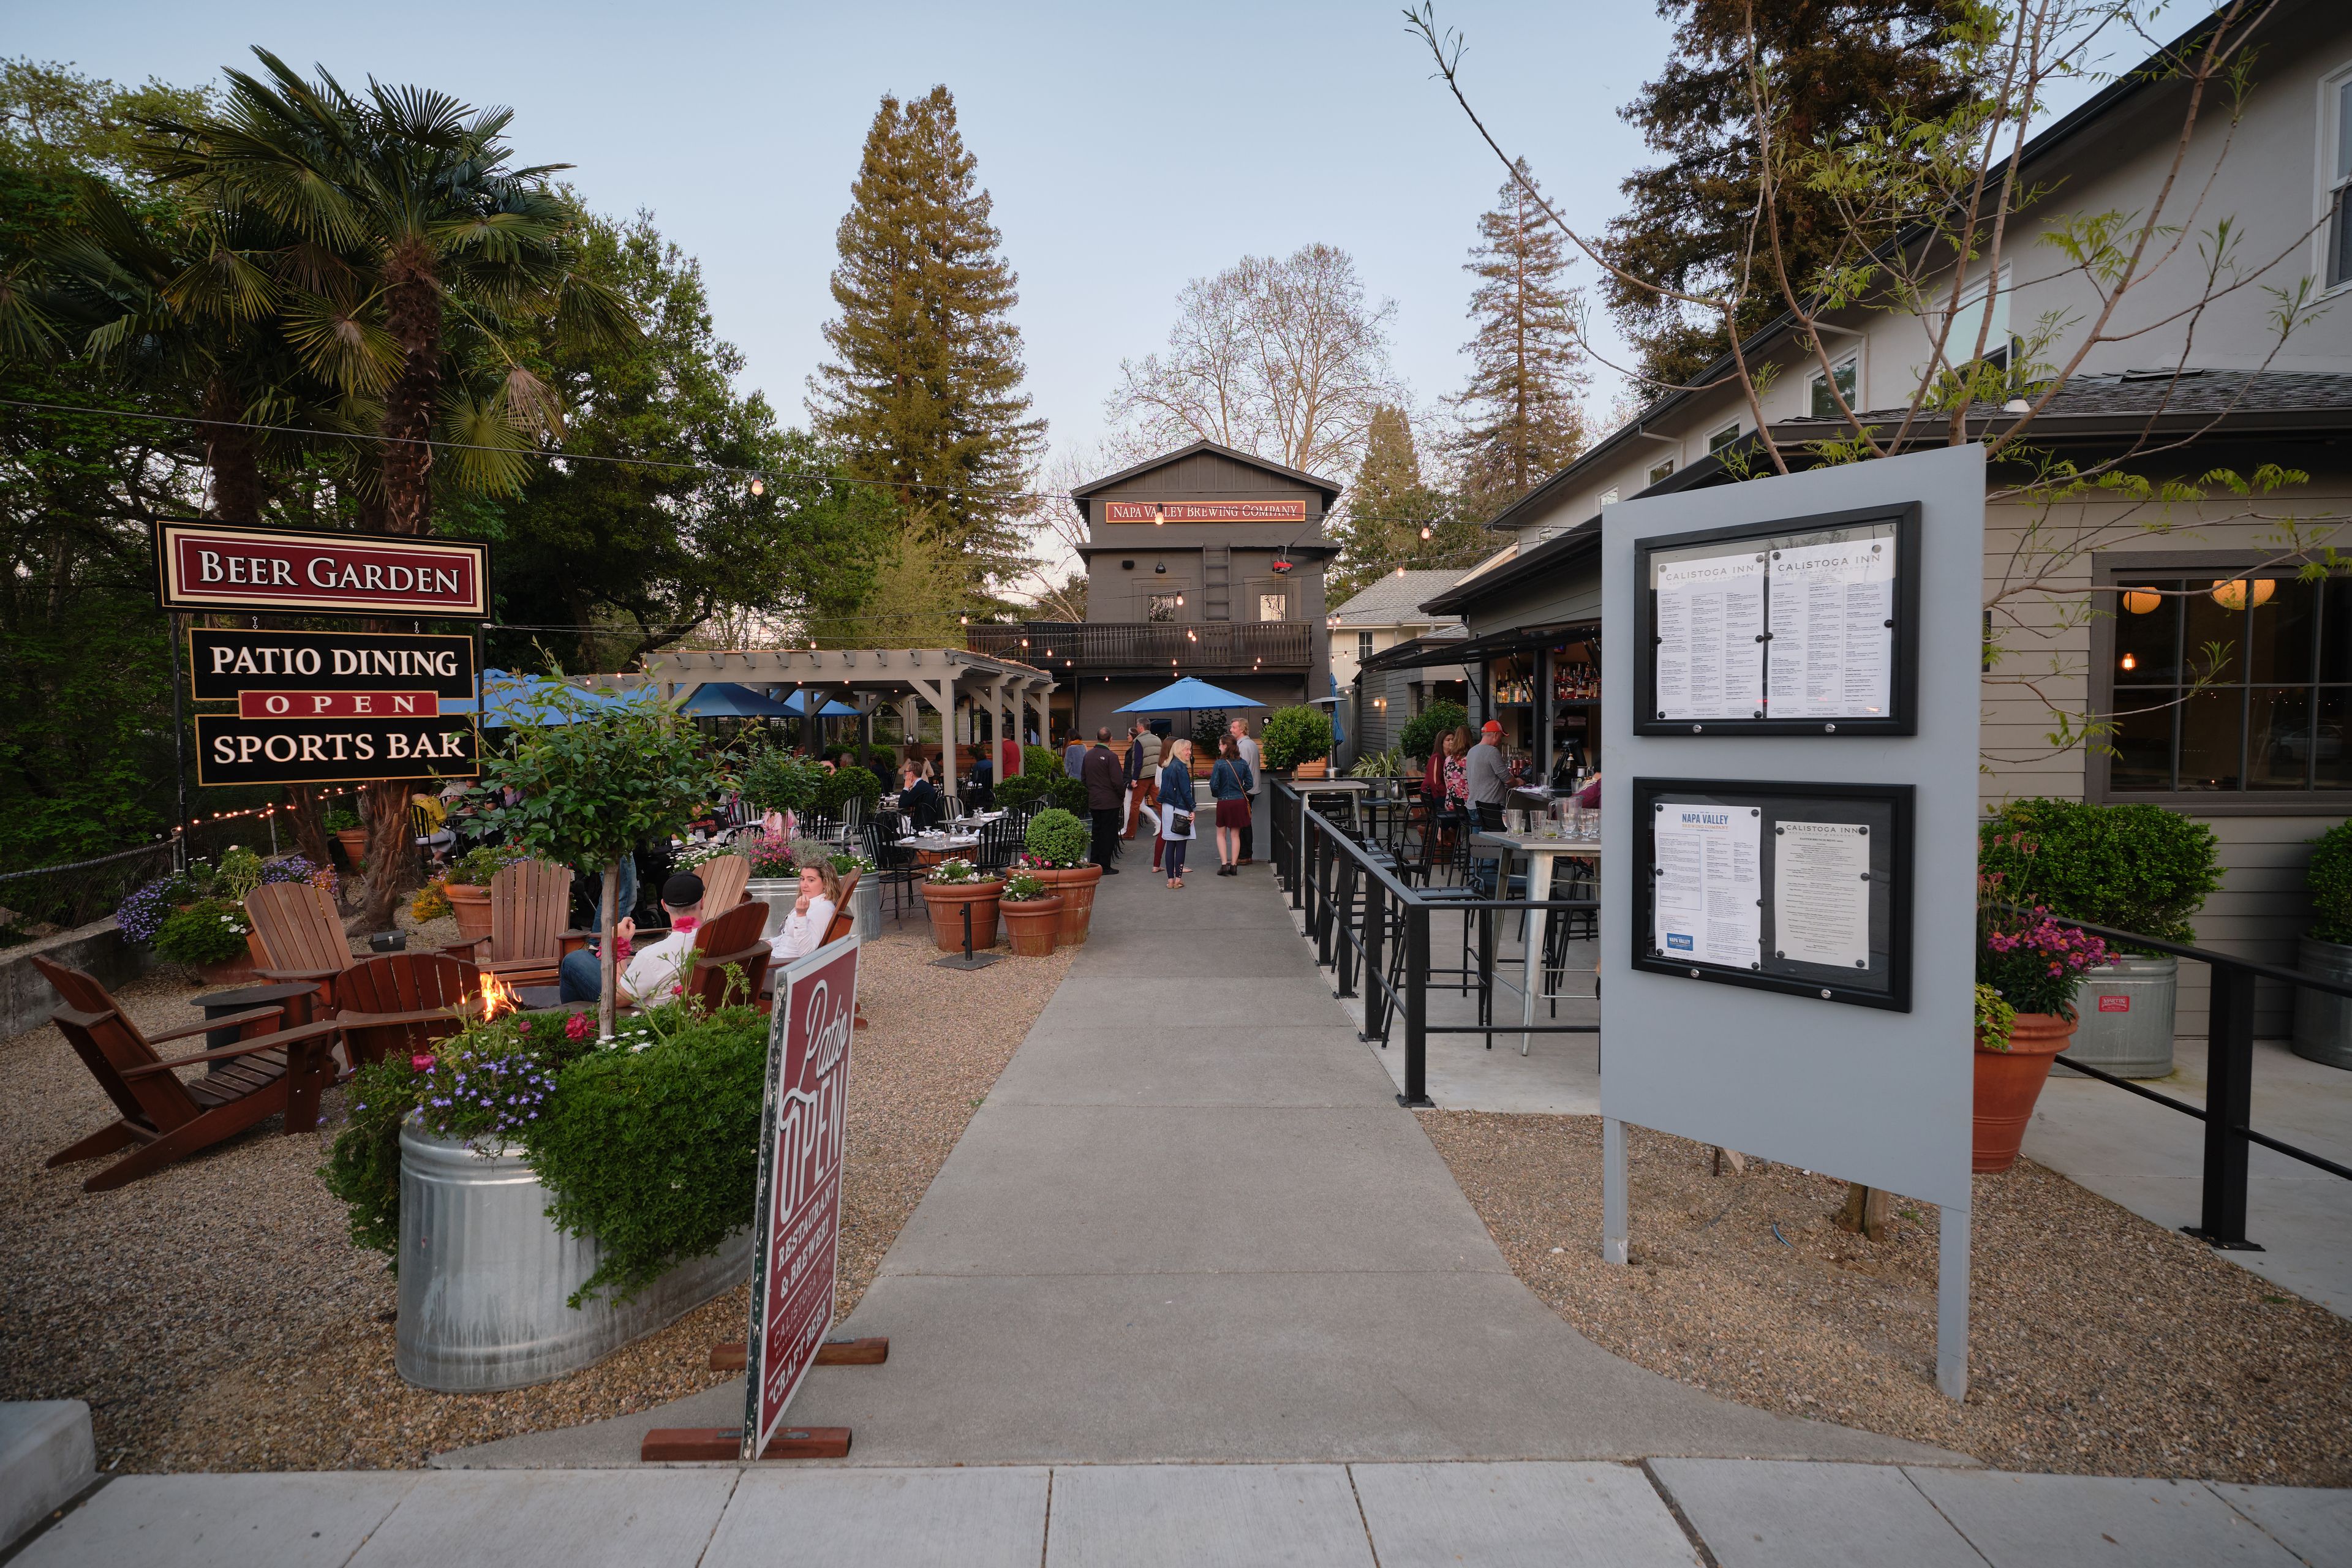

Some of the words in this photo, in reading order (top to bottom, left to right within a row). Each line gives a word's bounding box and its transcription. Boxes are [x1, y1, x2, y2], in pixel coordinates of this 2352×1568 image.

[1114, 506, 1142, 518] NAPA
[1144, 506, 1183, 518] VALEY
[1186, 505, 1238, 518] BREWING
[1242, 505, 1297, 517] COMPANY
[197, 549, 299, 587] BEER
[306, 556, 459, 594] GARDEN
[1665, 568, 1727, 581] CALISTOGA
[1732, 565, 1755, 575] INN
[1778, 557, 1849, 572] CALISTOGA
[1855, 554, 1881, 564] INN
[209, 646, 322, 675] PATIO
[330, 648, 459, 677] DINING
[265, 695, 417, 714] OPEN
[213, 733, 375, 765] SPORTS
[386, 732, 466, 759] BAR
[1682, 813, 1700, 824] NAPA
[1702, 814, 1728, 824] VALLEY
[1786, 824, 1836, 833] CALISTOGA
[780, 1060, 845, 1224] OPEN
[777, 1177, 835, 1272] RESTAURANT
[790, 1213, 831, 1287] BREWERY
[774, 1273, 816, 1348] CALISTOGA
[818, 1250, 832, 1280] INN
